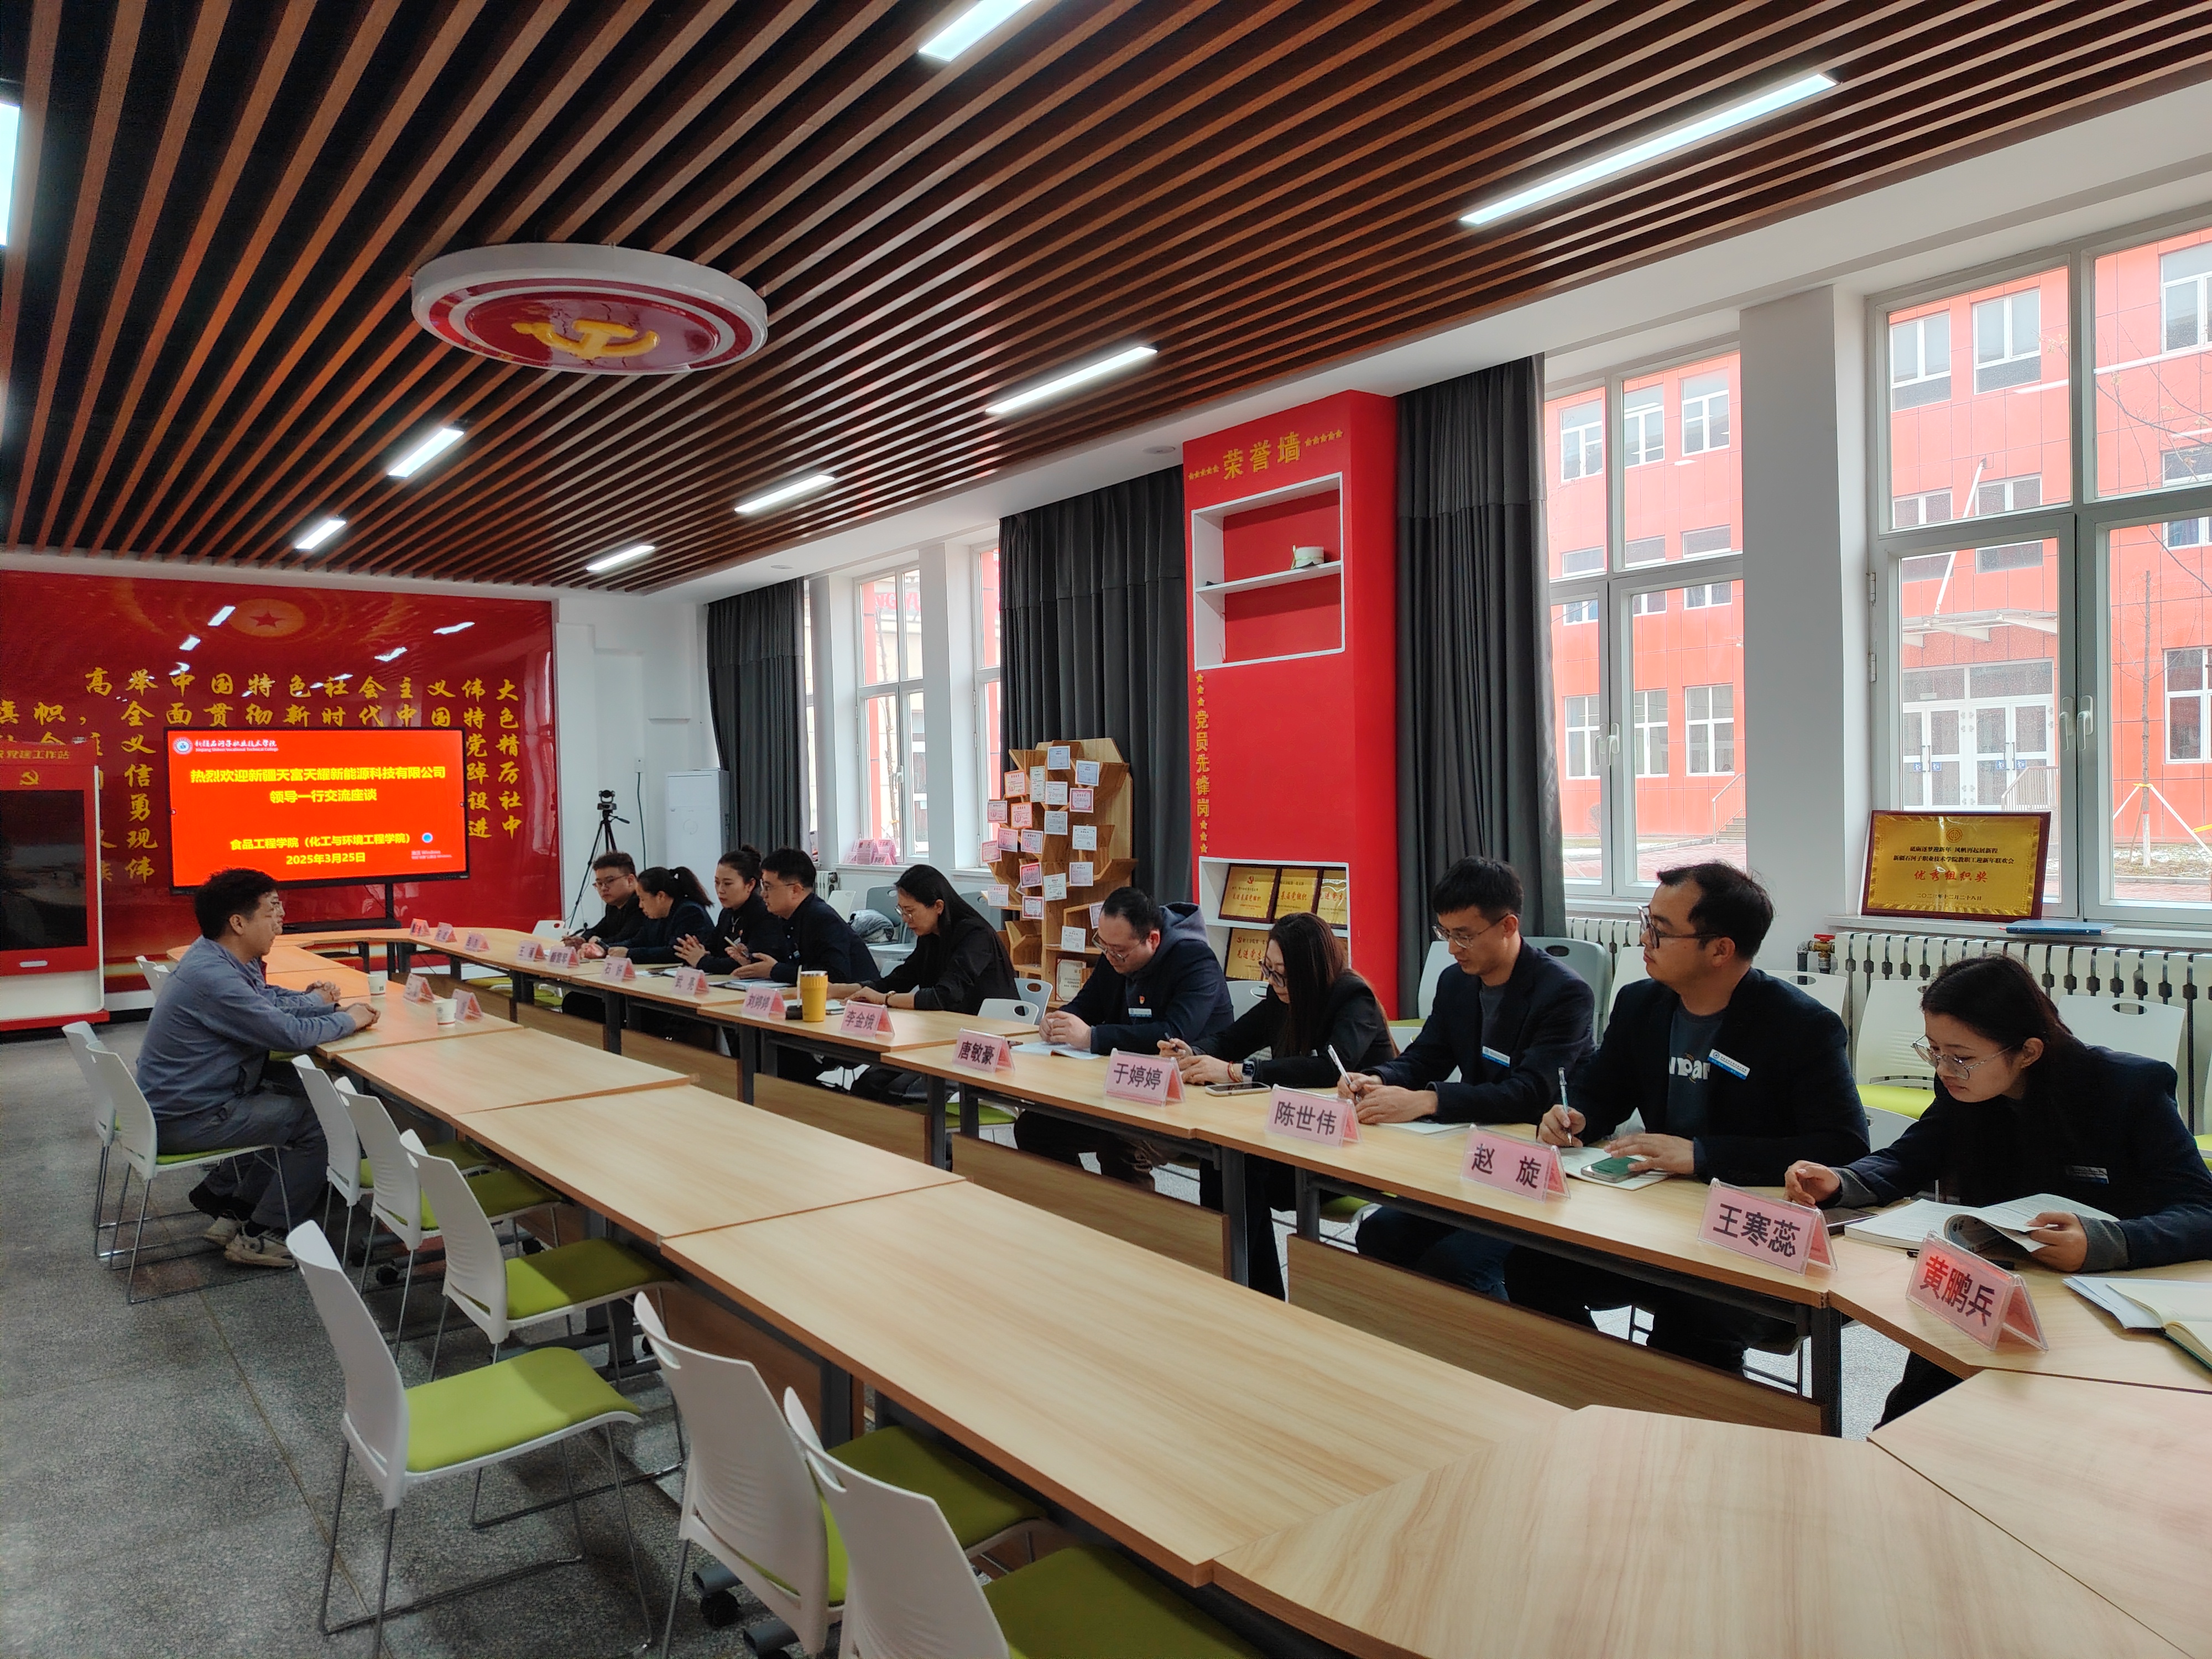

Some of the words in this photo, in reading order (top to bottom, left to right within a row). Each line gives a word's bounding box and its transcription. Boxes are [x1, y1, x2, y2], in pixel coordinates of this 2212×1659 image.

[1223, 431, 1301, 479] 荣誉墙
[85, 667, 519, 702] 高举中国特色社会主义伟大
[191, 766, 446, 783] 热烈欢迎新疆天富天耀新能源科技有限公司
[1195, 710, 1210, 817] 党员先锋岗
[270, 789, 377, 804] 领导一行交流座谈
[286, 852, 366, 865] 2025年3月25日
[1914, 870, 1988, 883] 优秀组织奖
[958, 1040, 995, 1066] 唐敏豪
[1113, 1062, 1163, 1090] 于婷婷
[1274, 1101, 1337, 1135] 陈世伟
[1713, 1203, 1801, 1258] 王寒蕊
[1919, 1255, 1996, 1327] 黄鹏兵
